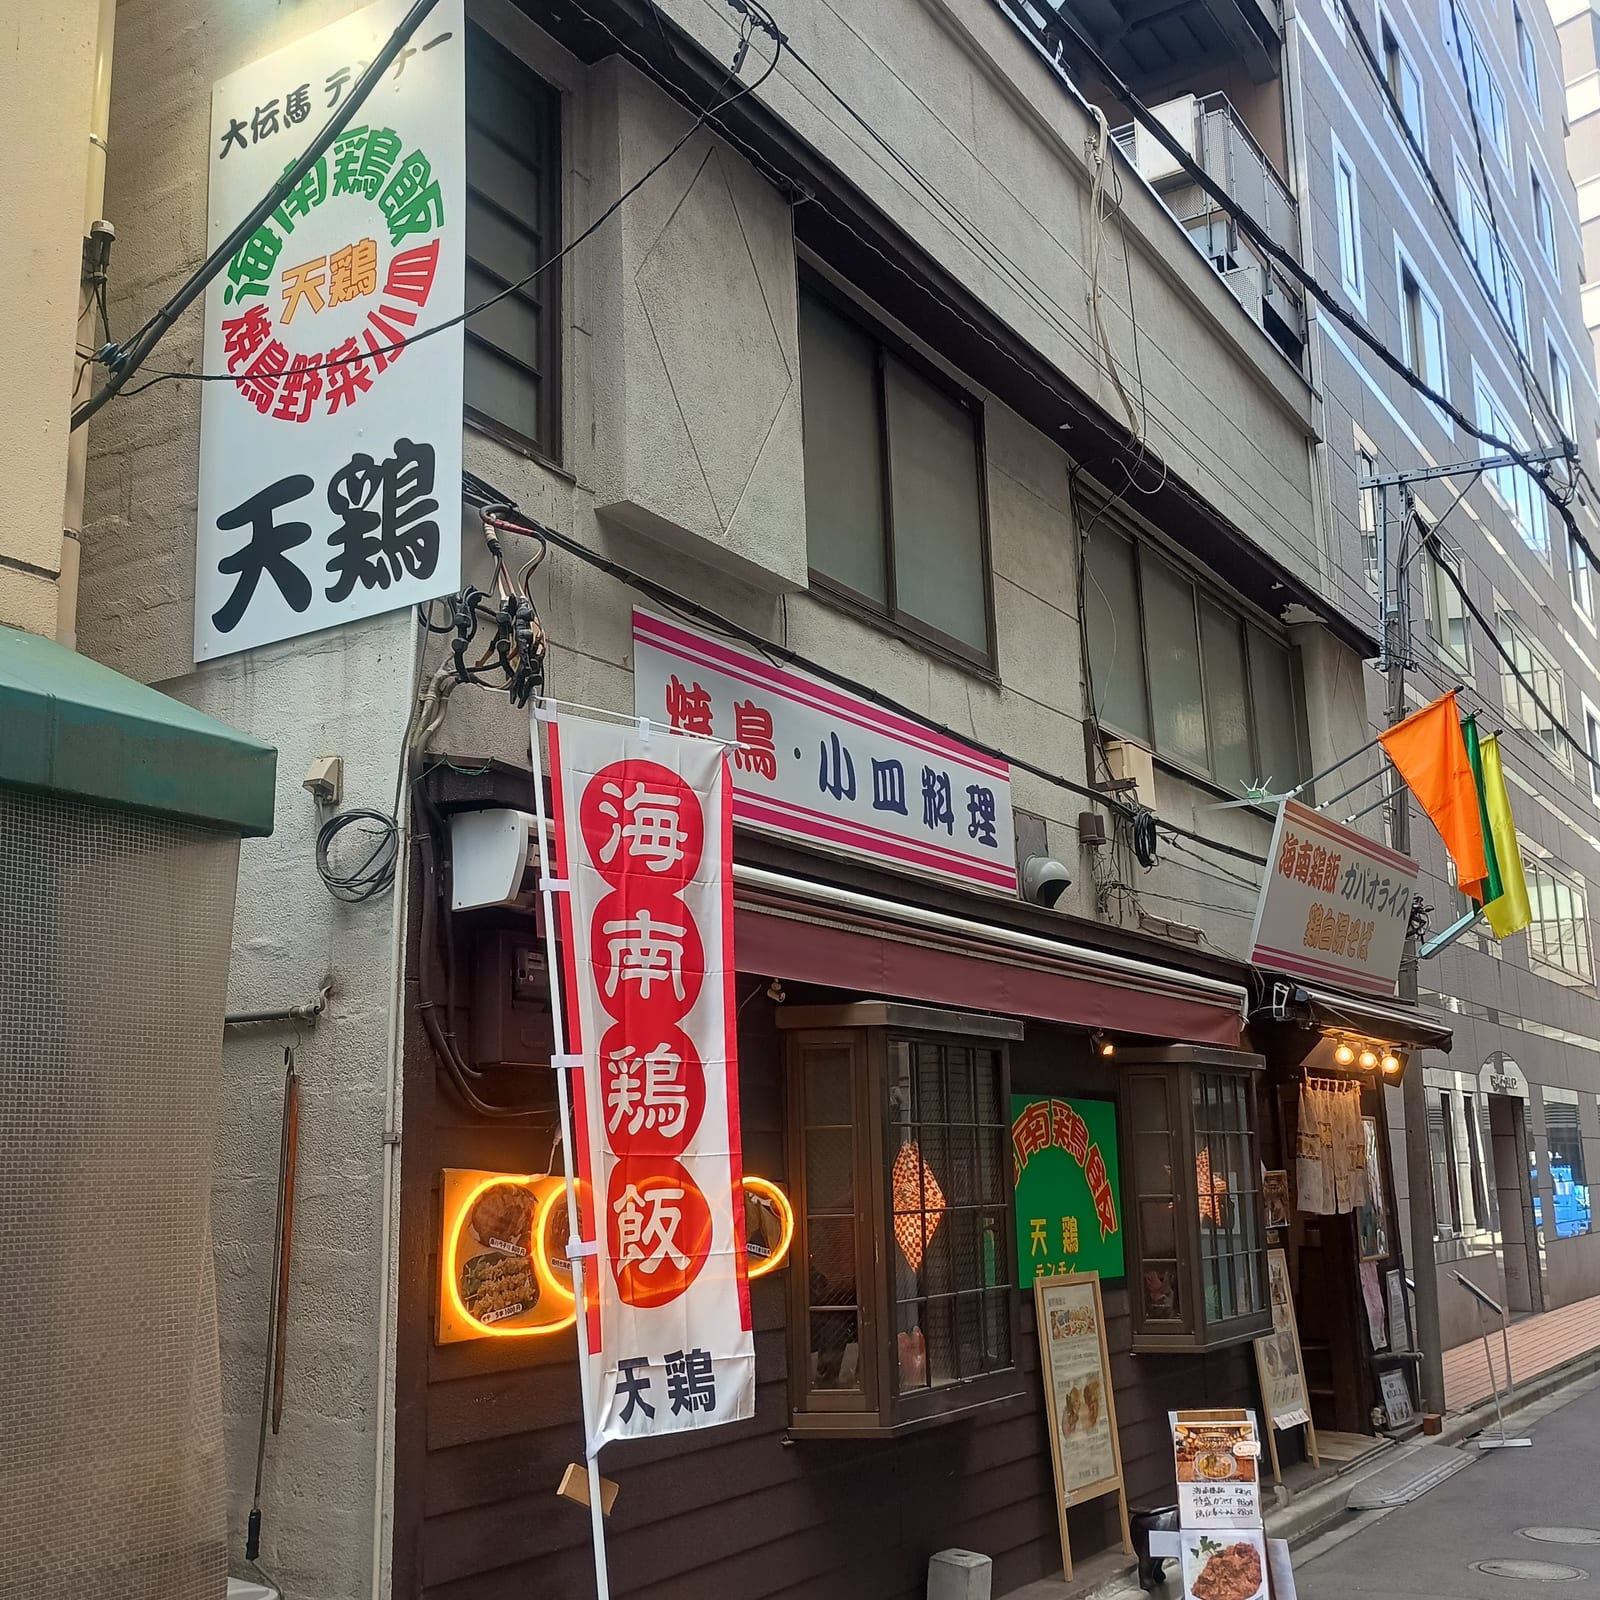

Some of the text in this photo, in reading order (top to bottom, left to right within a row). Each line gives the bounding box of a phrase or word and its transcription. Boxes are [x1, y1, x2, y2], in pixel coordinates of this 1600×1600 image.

[219, 83, 311, 159] 大伝馬
[281, 237, 377, 325] 天鶏
[211, 437, 440, 634] 天鶏
[598, 781, 692, 1278] 海南鶏飯
[1012, 1098, 1118, 1245] 南鶏飯
[614, 1348, 717, 1425] 天鶏
